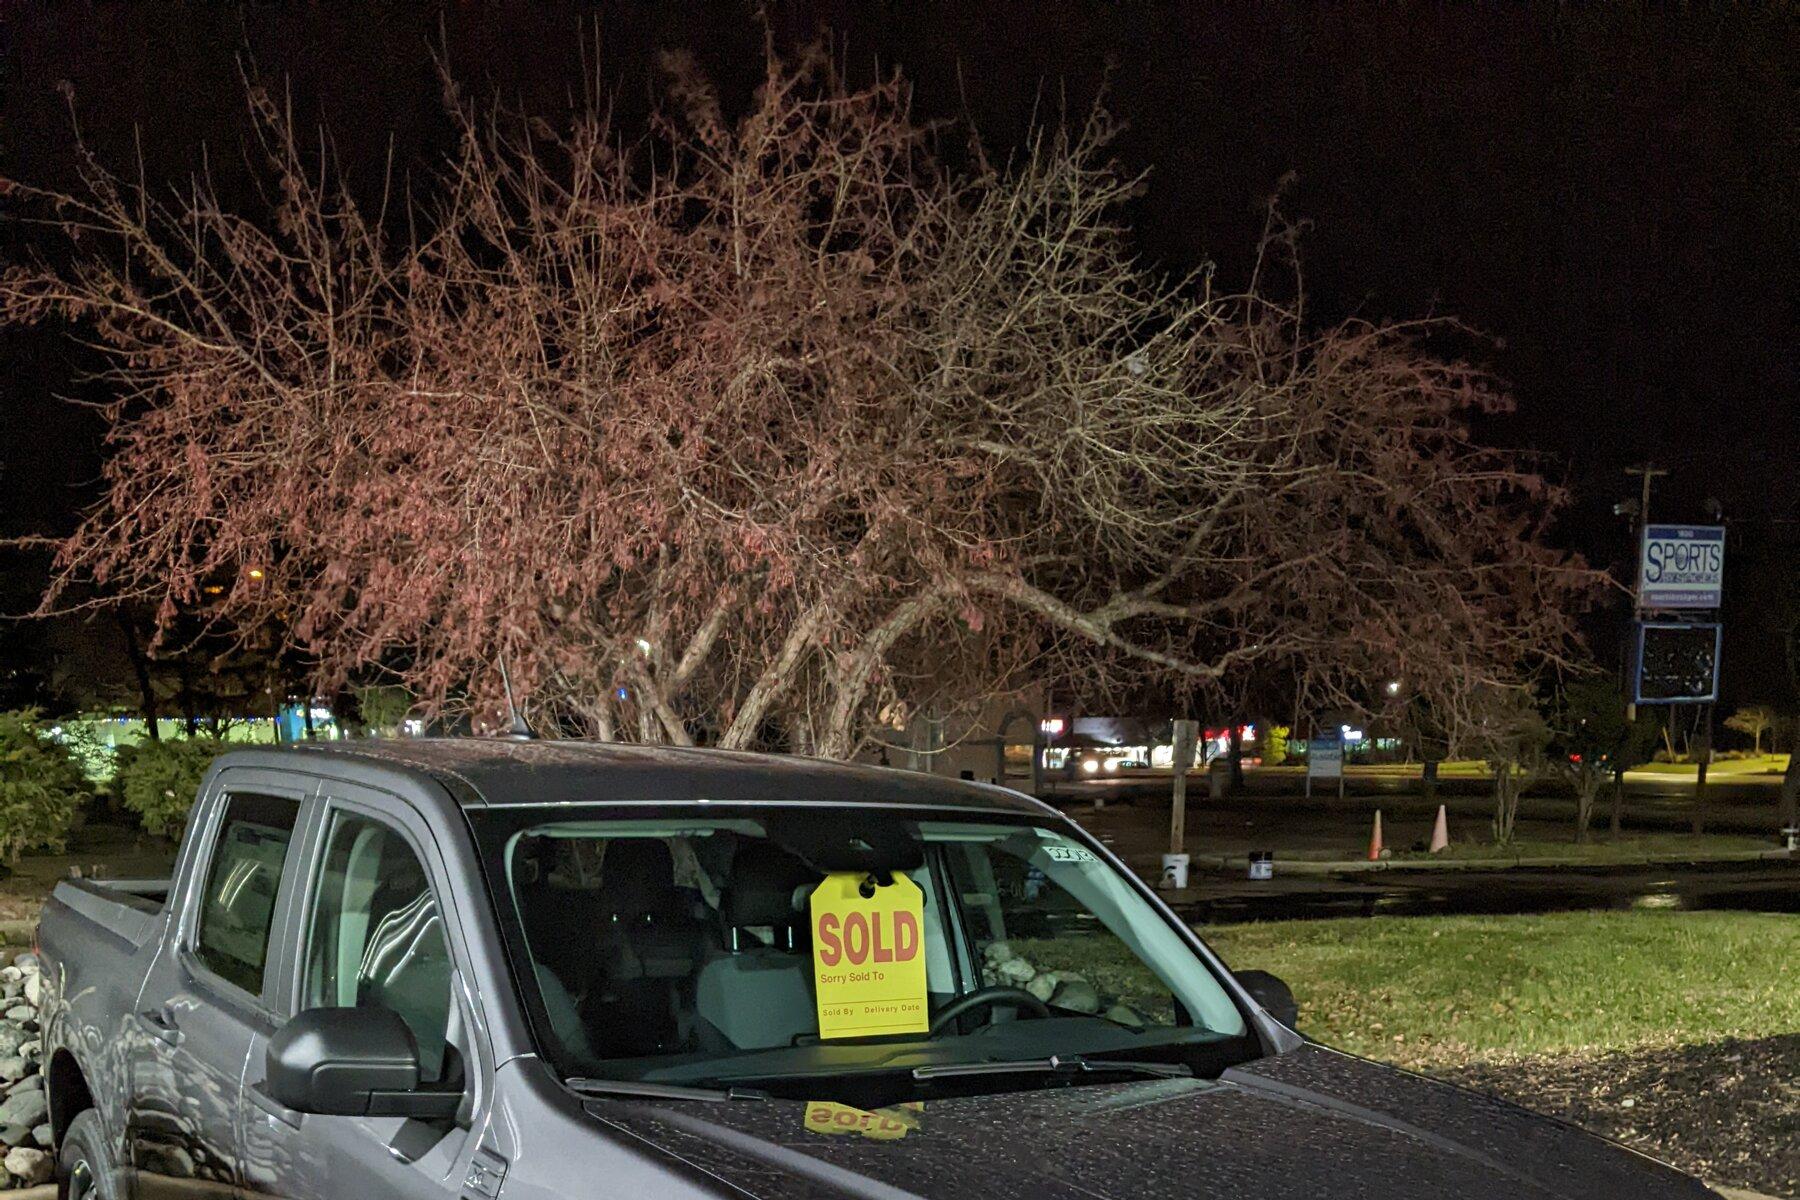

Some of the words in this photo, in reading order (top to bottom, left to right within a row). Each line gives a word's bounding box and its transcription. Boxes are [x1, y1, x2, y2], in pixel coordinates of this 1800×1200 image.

[1645, 541, 1721, 583] SPORTS
[818, 910, 919, 967] SOLD
[820, 974, 847, 985] Sorry
[849, 972, 870, 982] Sold
[872, 971, 885, 981] To
[822, 1009, 841, 1017] Sold
[843, 1008, 854, 1016] By
[864, 1005, 898, 1014] Delivery
[901, 1004, 920, 1012] Date
